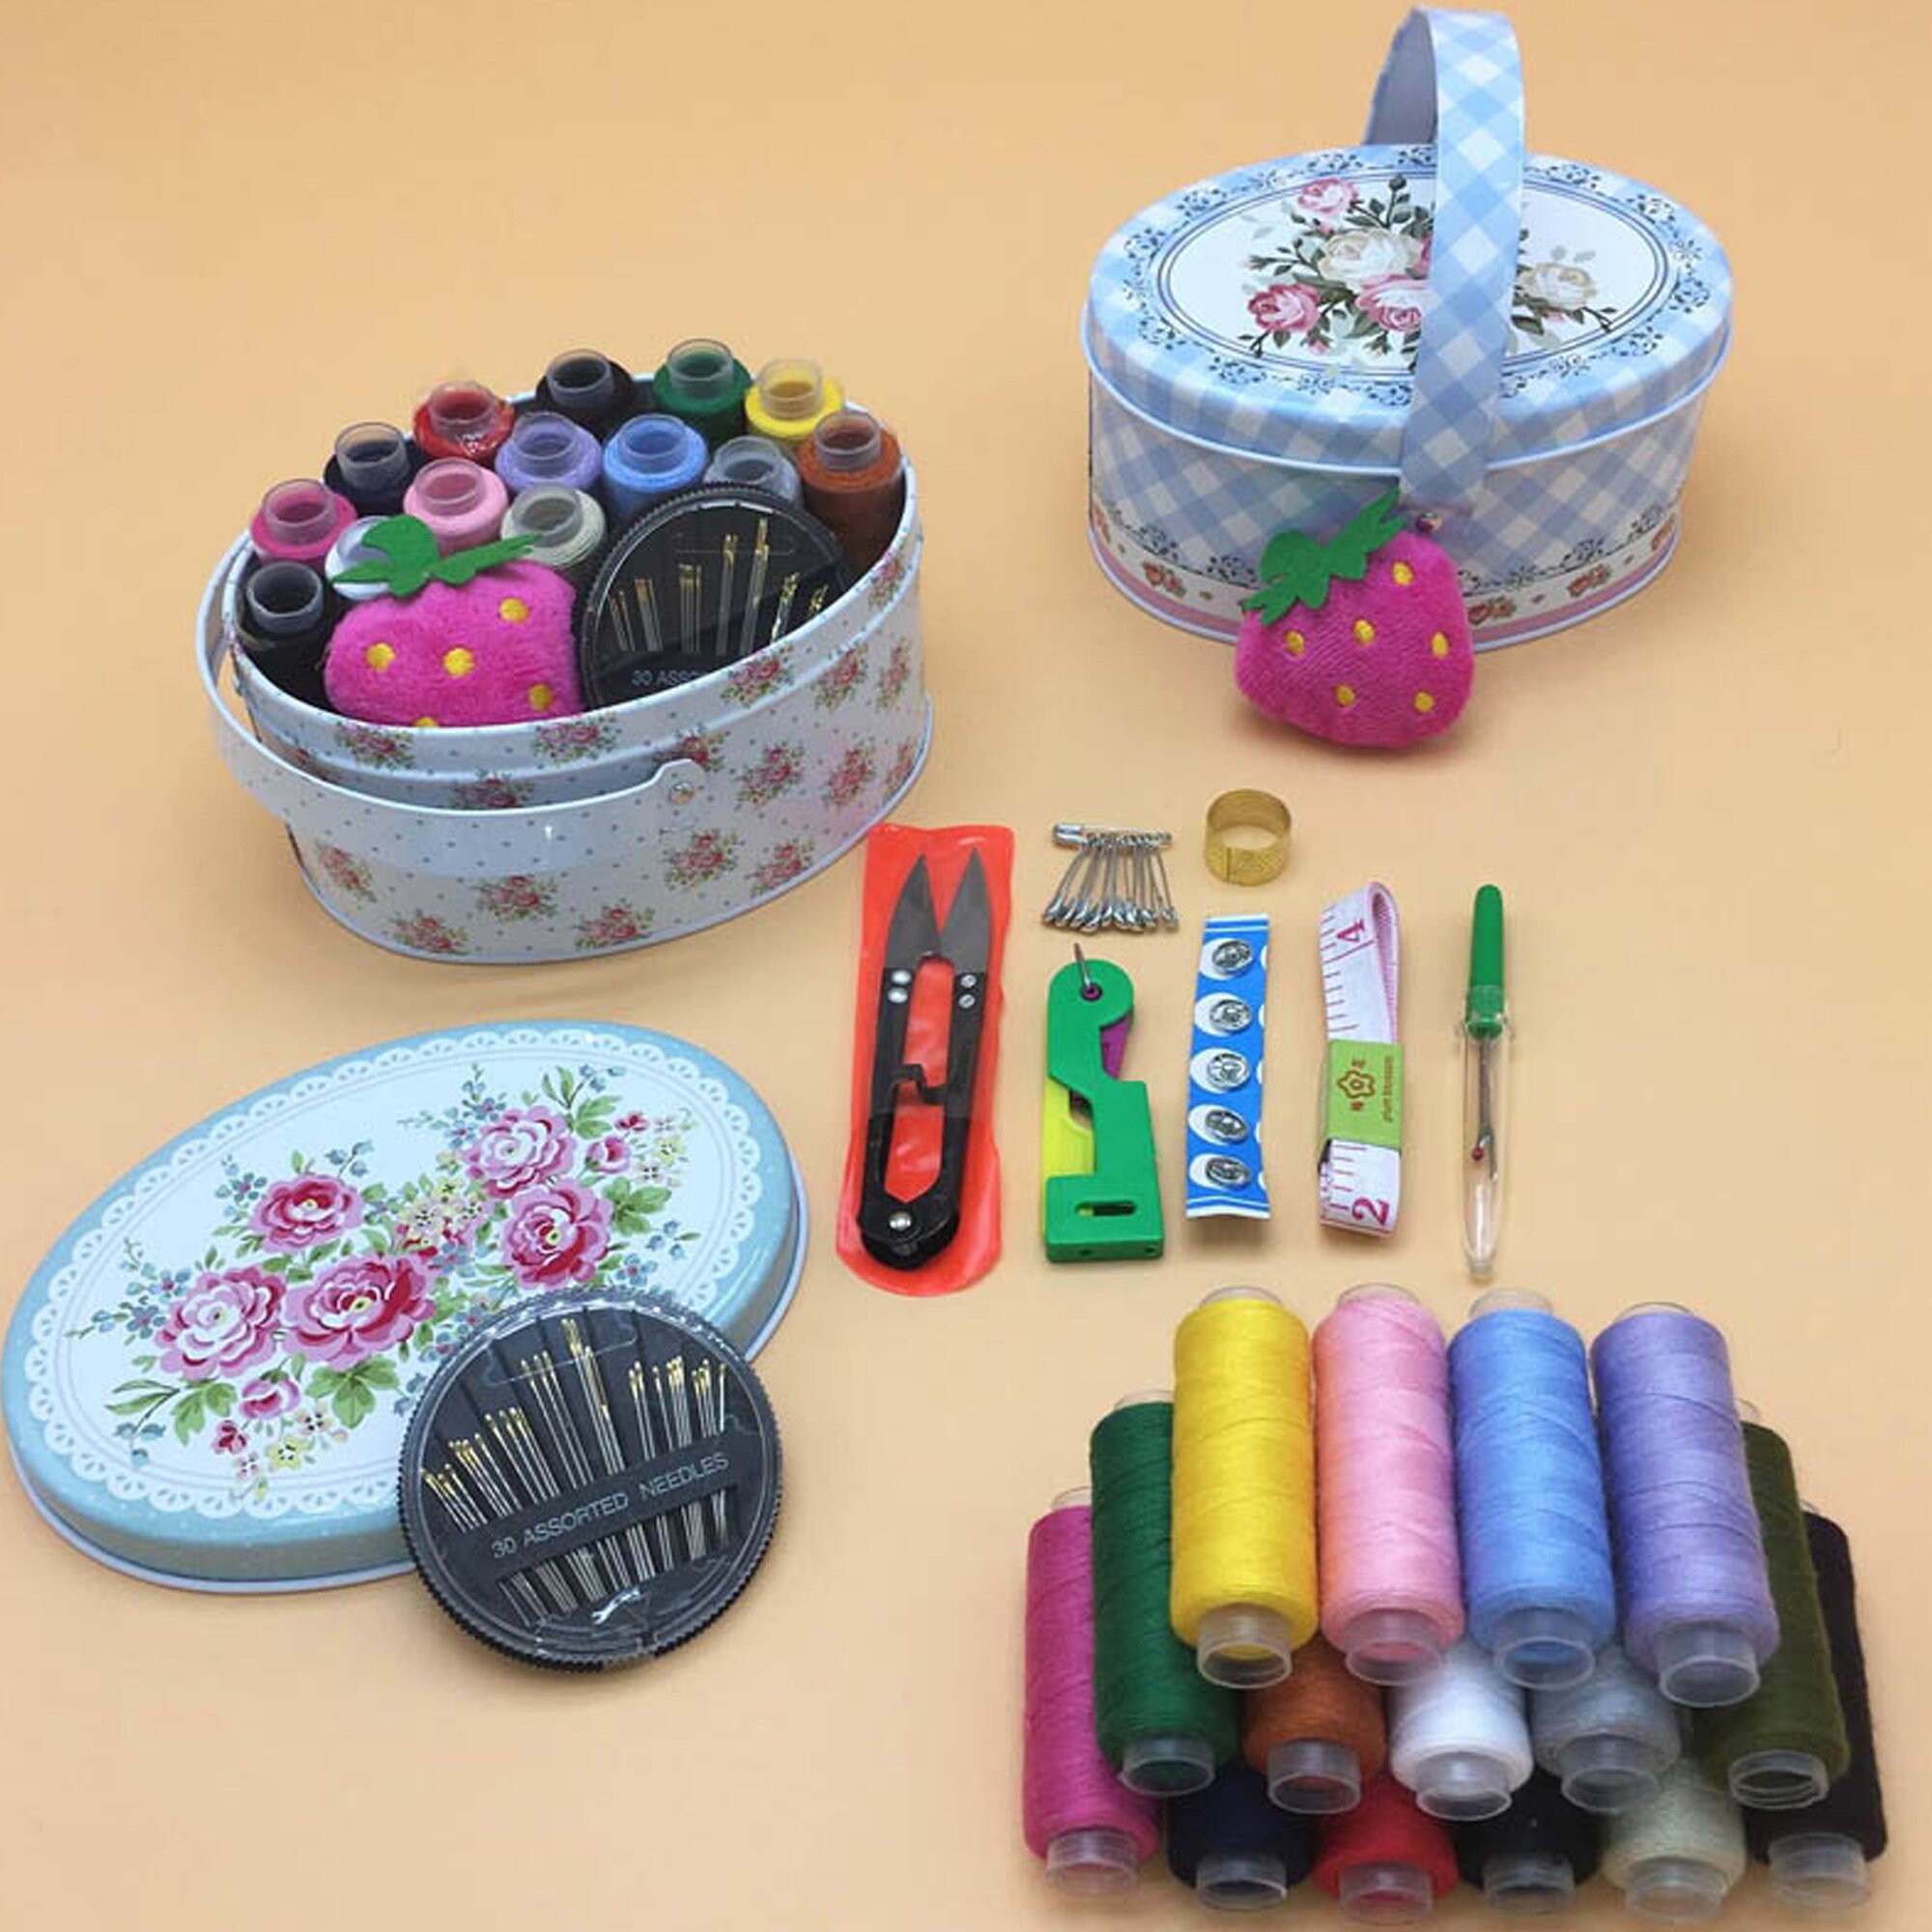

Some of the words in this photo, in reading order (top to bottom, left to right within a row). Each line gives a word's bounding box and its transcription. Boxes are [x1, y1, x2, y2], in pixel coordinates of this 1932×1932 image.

[632, 669, 653, 686] 30
[1336, 918, 1366, 944] 4
[1351, 1197, 1390, 1226] 2
[492, 1536, 517, 1558] 30
[523, 1492, 629, 1547] ASSORTED
[639, 1453, 729, 1498] NEEDLES
